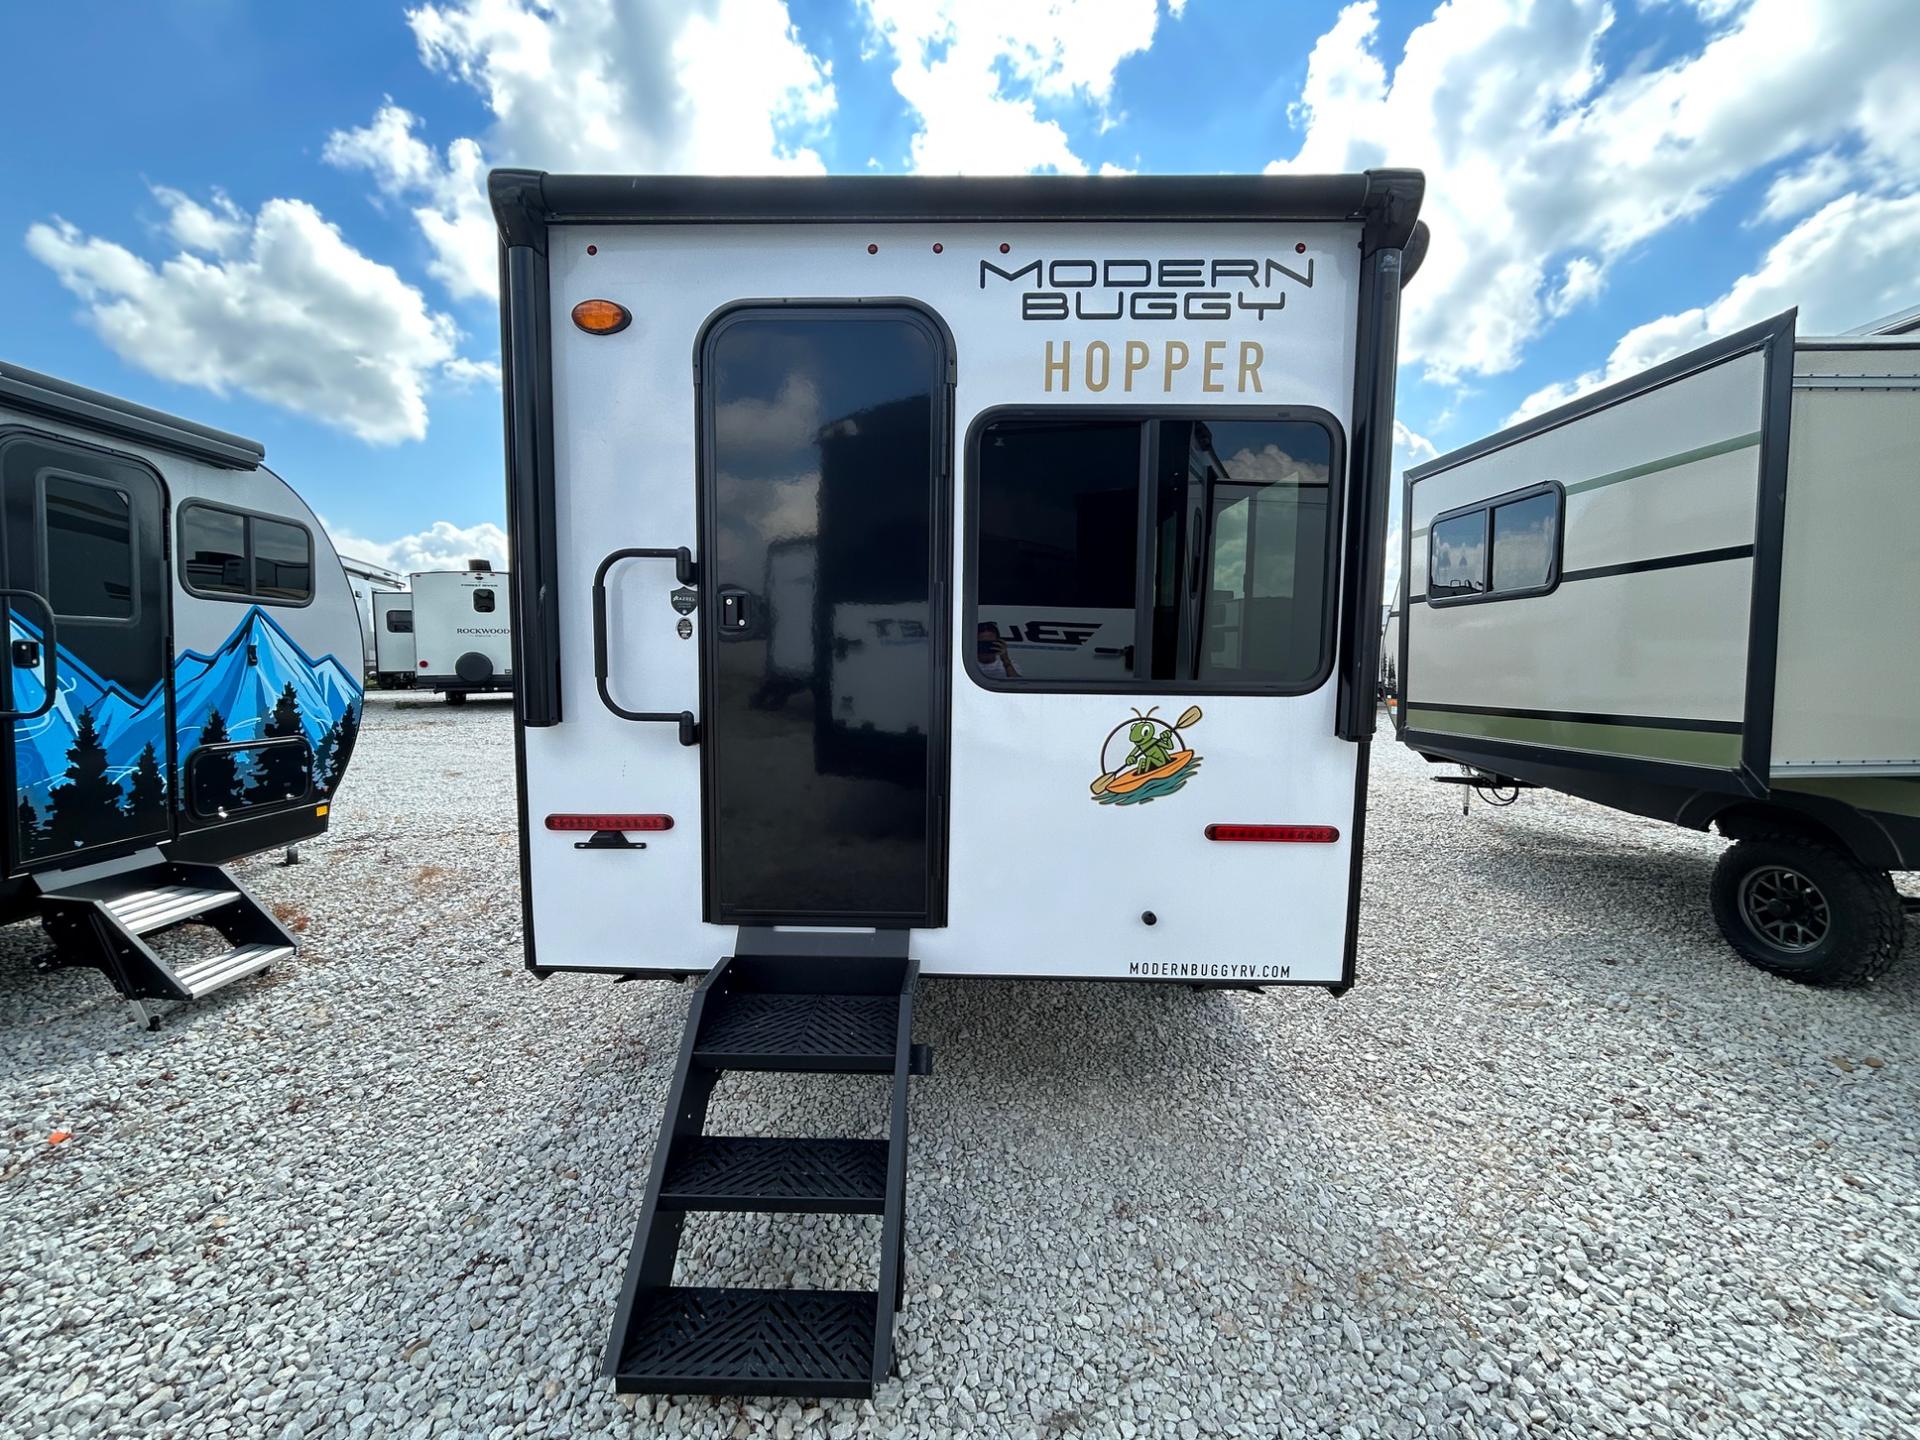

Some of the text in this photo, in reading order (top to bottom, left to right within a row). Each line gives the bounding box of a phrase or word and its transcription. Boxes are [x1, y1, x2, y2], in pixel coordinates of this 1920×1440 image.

[980, 258, 1314, 289] MODERN
[1022, 291, 1286, 321] BUGGY
[1044, 340, 1265, 393] HOPPER
[1129, 962, 1291, 979] MODERNBUGGYRV.COM
